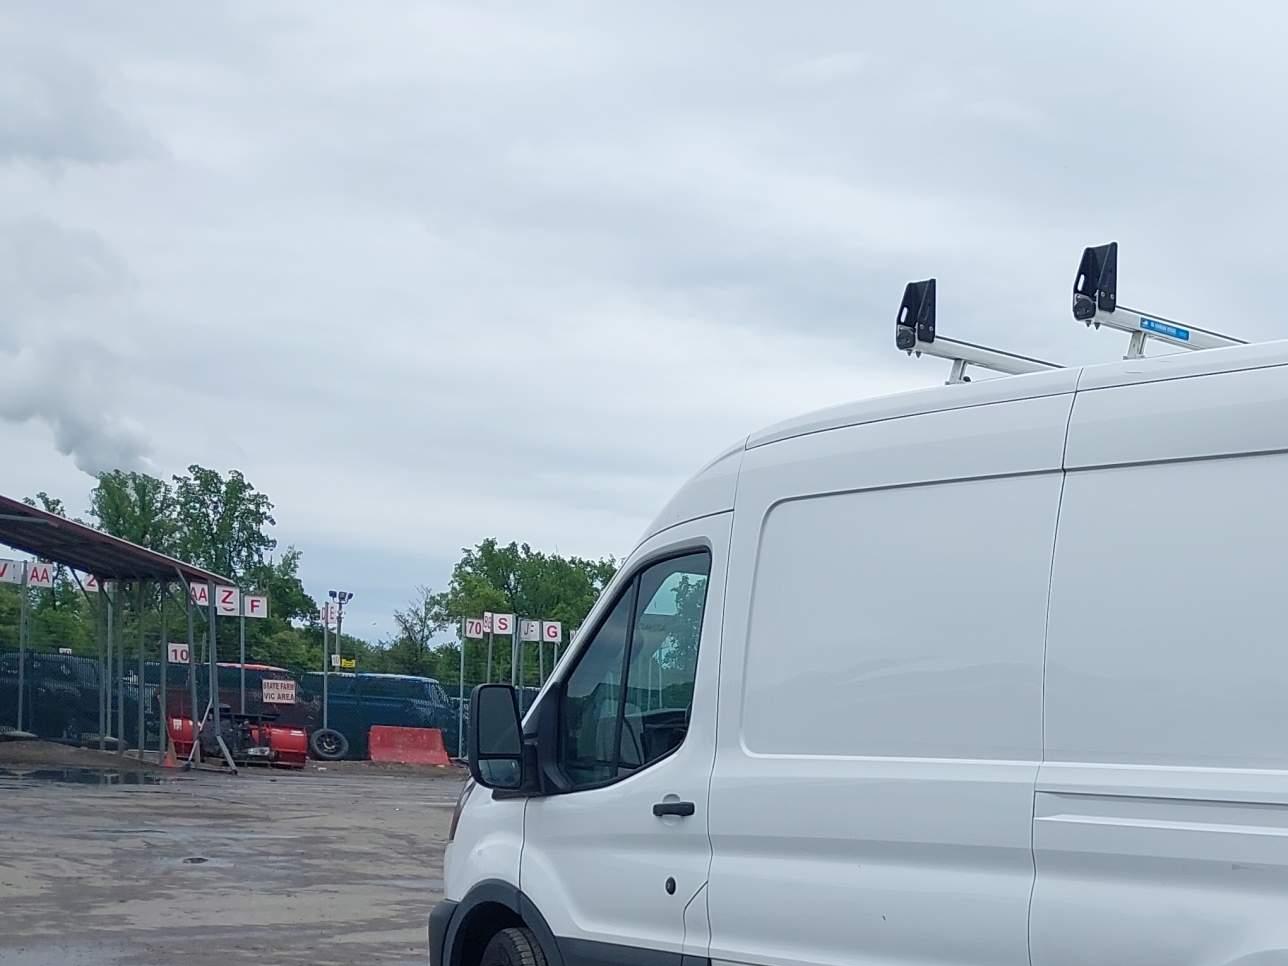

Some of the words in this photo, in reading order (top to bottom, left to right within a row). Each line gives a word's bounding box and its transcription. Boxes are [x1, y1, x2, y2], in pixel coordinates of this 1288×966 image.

[30, 567, 50, 583] AA
[190, 587, 208, 602] AA
[221, 590, 234, 604] Z
[250, 599, 261, 613] F
[468, 621, 482, 635] 70
[498, 618, 508, 631] S
[547, 625, 558, 638] G
[171, 649, 188, 661] 10
[263, 692, 275, 700] VIC
[277, 692, 295, 701] AREA
